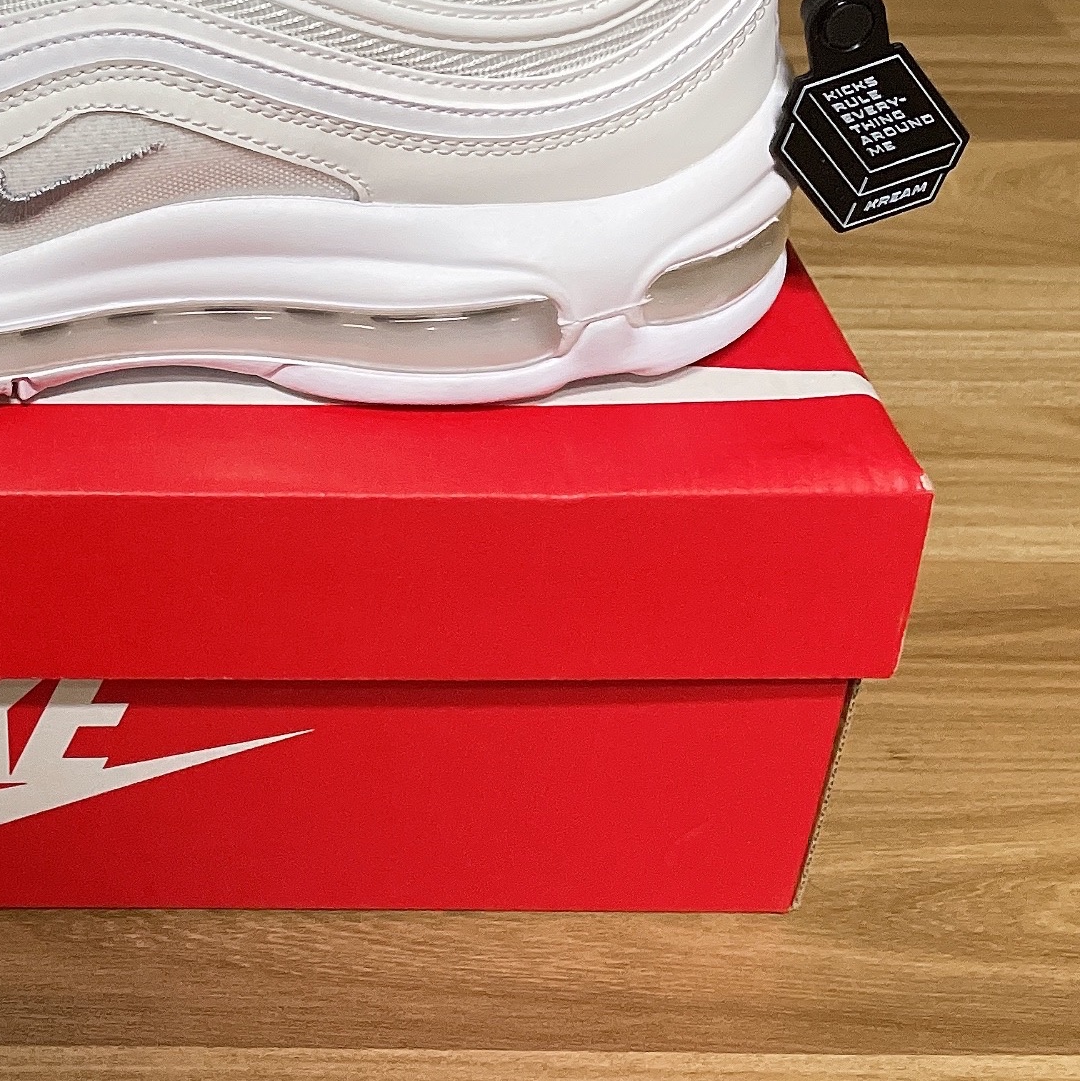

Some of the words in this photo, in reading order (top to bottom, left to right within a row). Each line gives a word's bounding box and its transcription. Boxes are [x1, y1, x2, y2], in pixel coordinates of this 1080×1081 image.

[822, 76, 878, 102] KICKS
[831, 89, 882, 113] RULE
[840, 96, 907, 124] EVERY-
[849, 109, 906, 134] THING
[860, 113, 935, 146] AROUND
[866, 140, 896, 157] ME
[863, 181, 928, 212] KREAM
